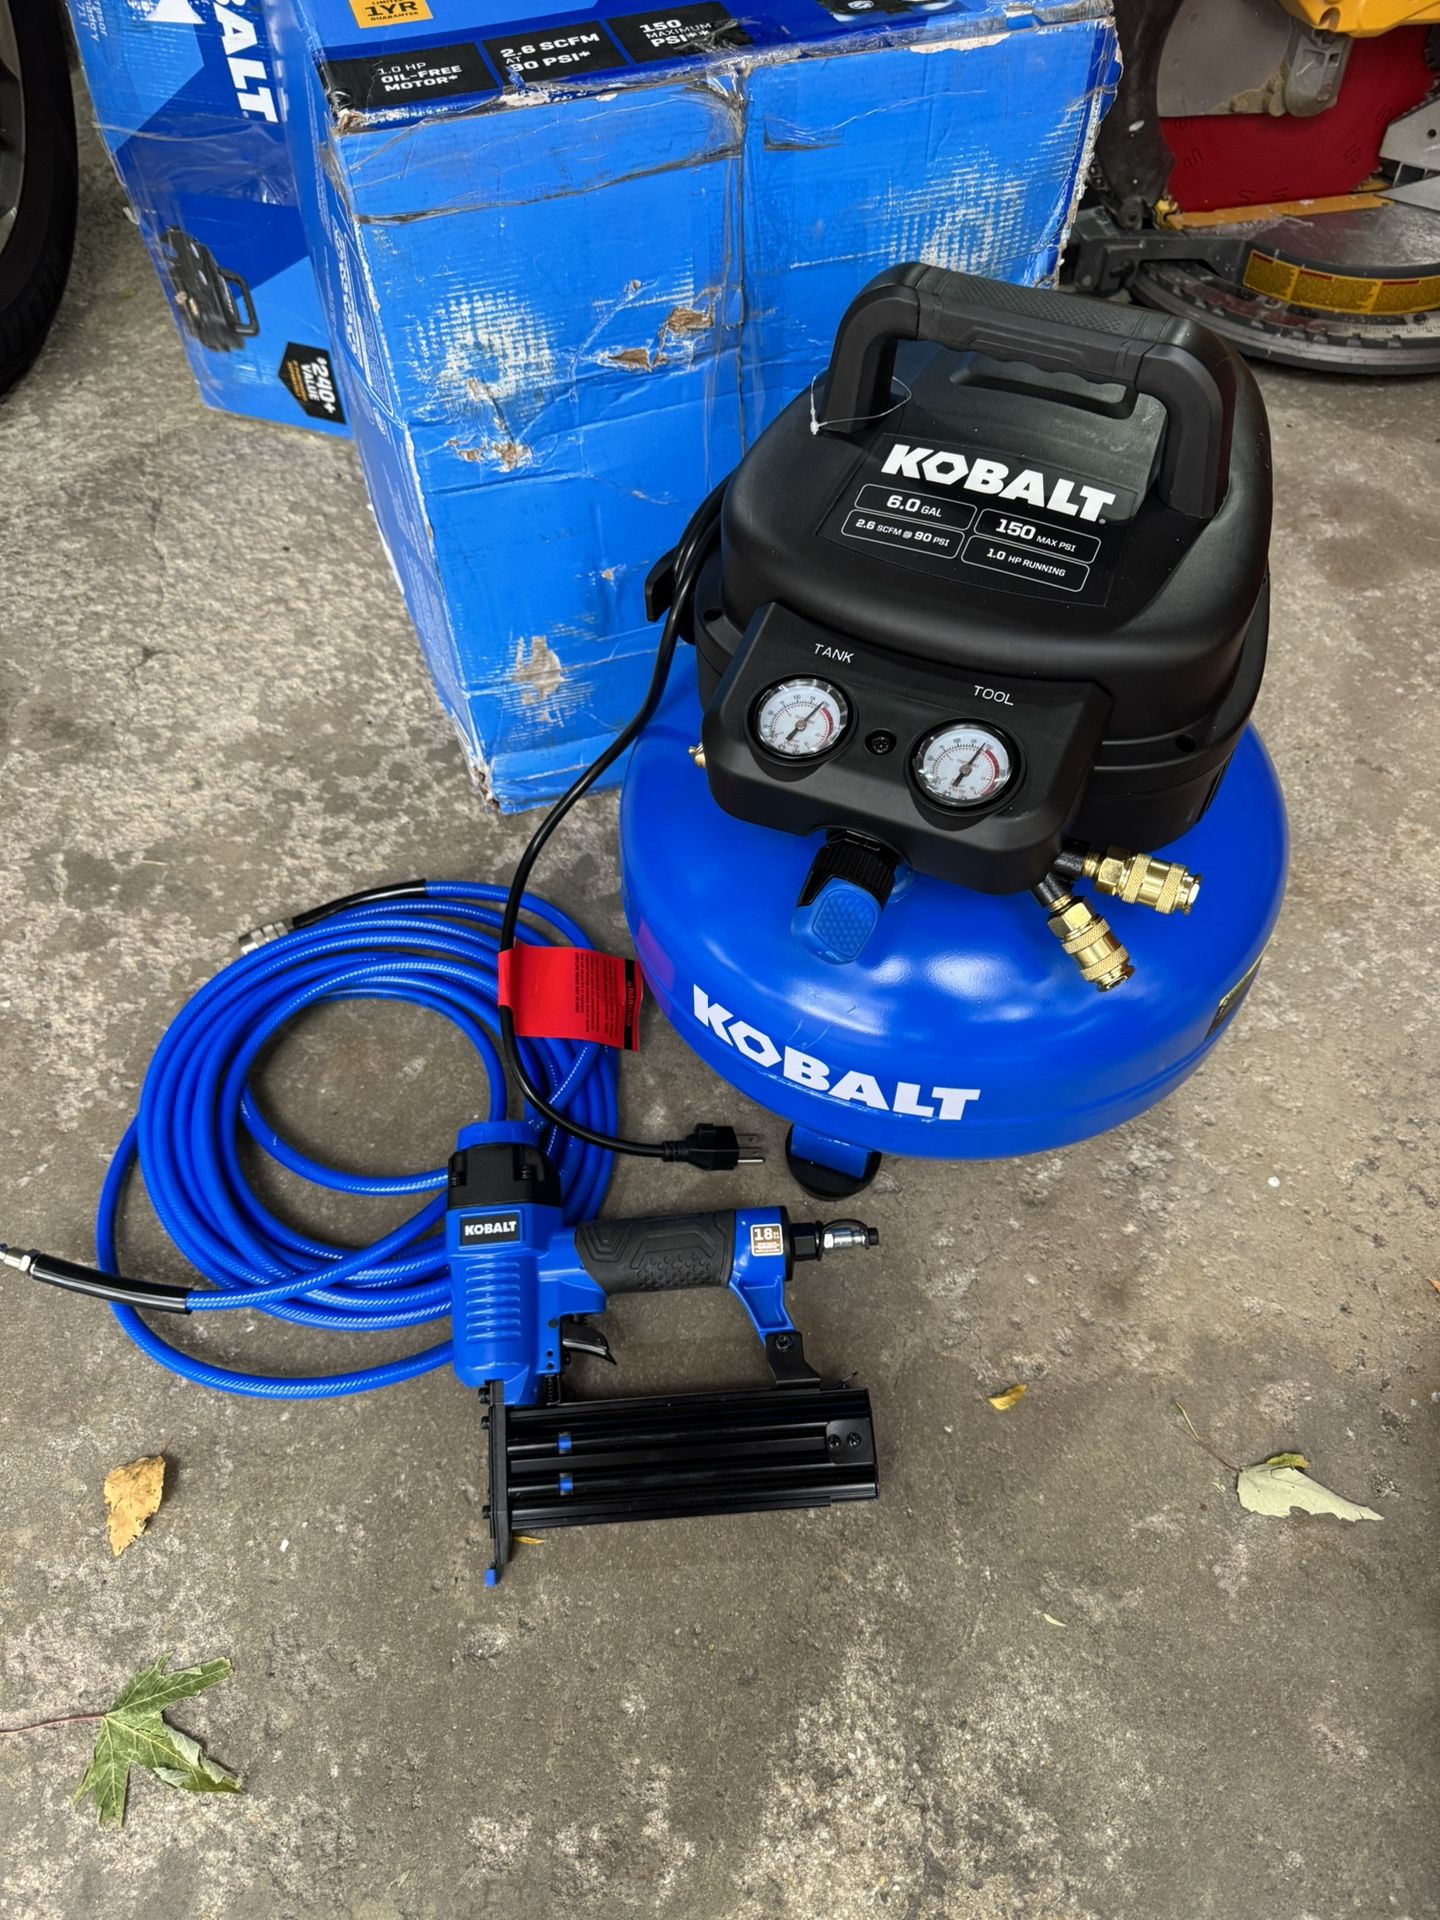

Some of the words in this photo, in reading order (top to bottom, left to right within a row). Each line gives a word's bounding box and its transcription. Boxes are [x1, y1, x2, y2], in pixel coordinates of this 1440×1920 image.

[364, 1, 418, 17] 1YR
[370, 11, 419, 21] GUARANTEE
[640, 19, 682, 33] 150
[646, 23, 712, 39] MAXIMUM
[500, 45, 537, 58] 2.6
[539, 33, 600, 51] SCFM
[213, 0, 279, 123] ALT
[377, 66, 401, 75] 1.0
[405, 62, 427, 71] HP
[506, 56, 521, 64] AT
[509, 61, 539, 72] 90
[381, 65, 462, 83] OIL-FREE
[301, 363, 320, 402] VALUE
[881, 443, 1117, 523] KOBALT
[886, 494, 921, 513] 6.0
[920, 504, 942, 518] GAL
[855, 518, 876, 530] 2.6
[876, 524, 902, 537] SCFM
[914, 531, 932, 543] 90
[932, 536, 950, 547] PSI
[995, 518, 1036, 540] 150
[1036, 535, 1057, 548] MAX
[1058, 541, 1077, 553] PSI
[986, 548, 1006, 561] 1.0
[1007, 555, 1022, 565] HP
[1022, 558, 1066, 577] RUNNING
[814, 643, 855, 664] TANK
[973, 685, 1015, 706] TOOL
[692, 983, 982, 1121] KOBALT
[464, 1220, 518, 1237] KOBALT
[754, 1227, 773, 1241] 18
